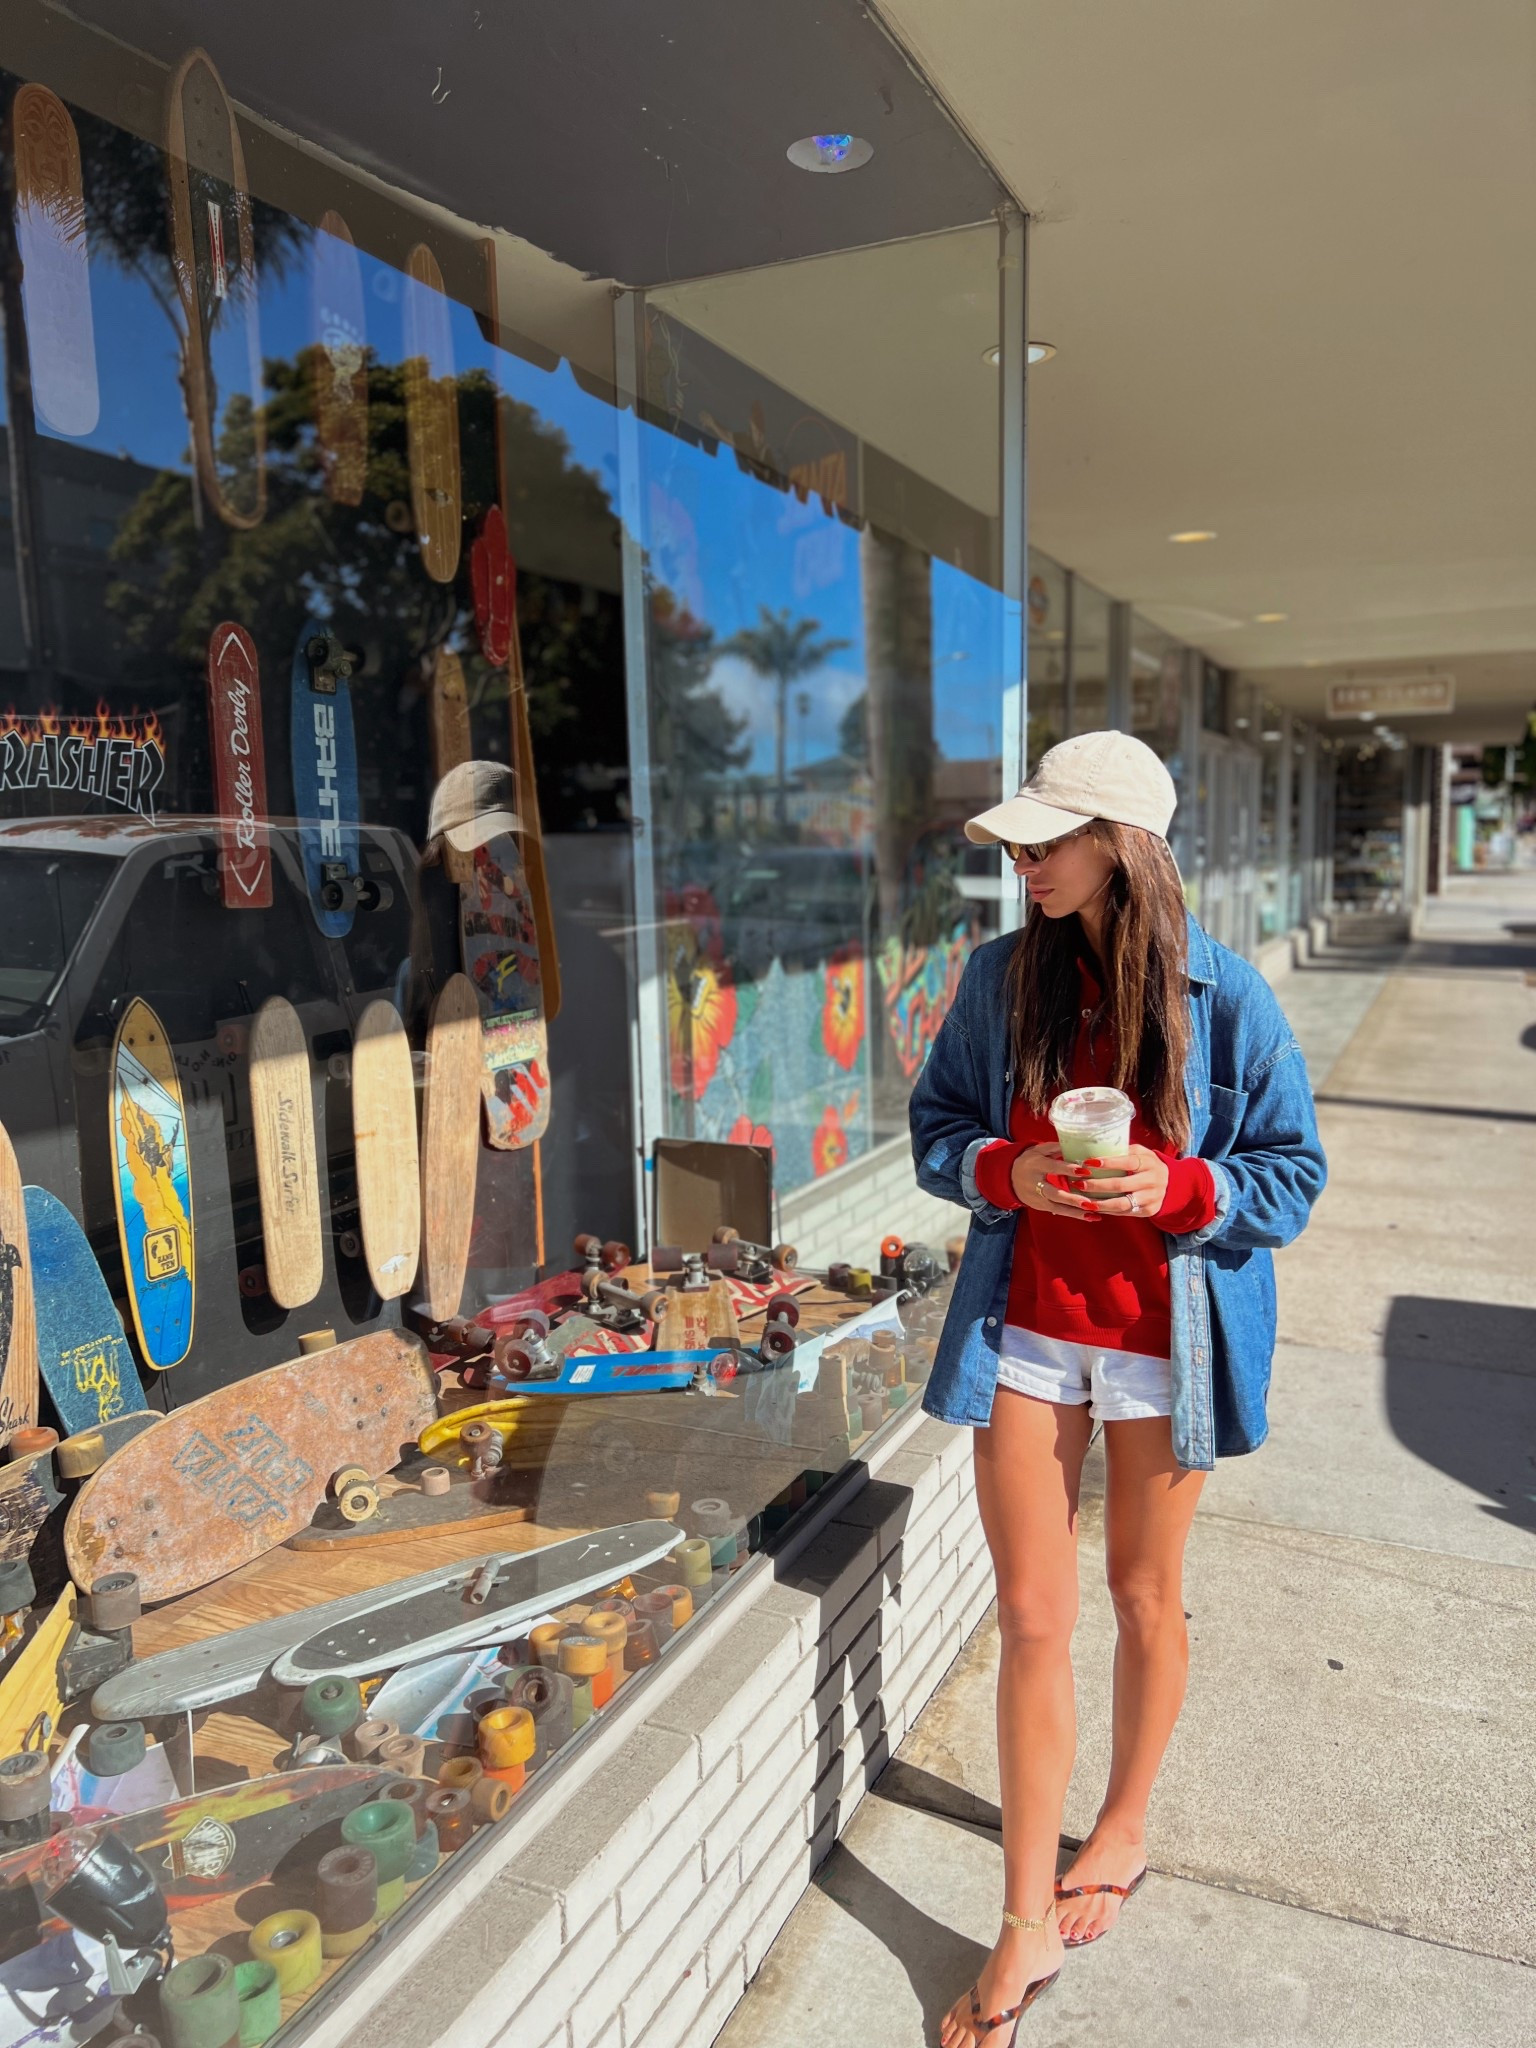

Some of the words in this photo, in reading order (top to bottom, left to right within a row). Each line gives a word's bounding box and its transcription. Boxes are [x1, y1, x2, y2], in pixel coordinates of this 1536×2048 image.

[229, 677, 252, 757] Derby
[235, 758, 257, 851] Roller
[277, 1090, 296, 1163] Sidewalk
[281, 1166, 301, 1215] Surfer
[160, 1259, 175, 1271] TEN
